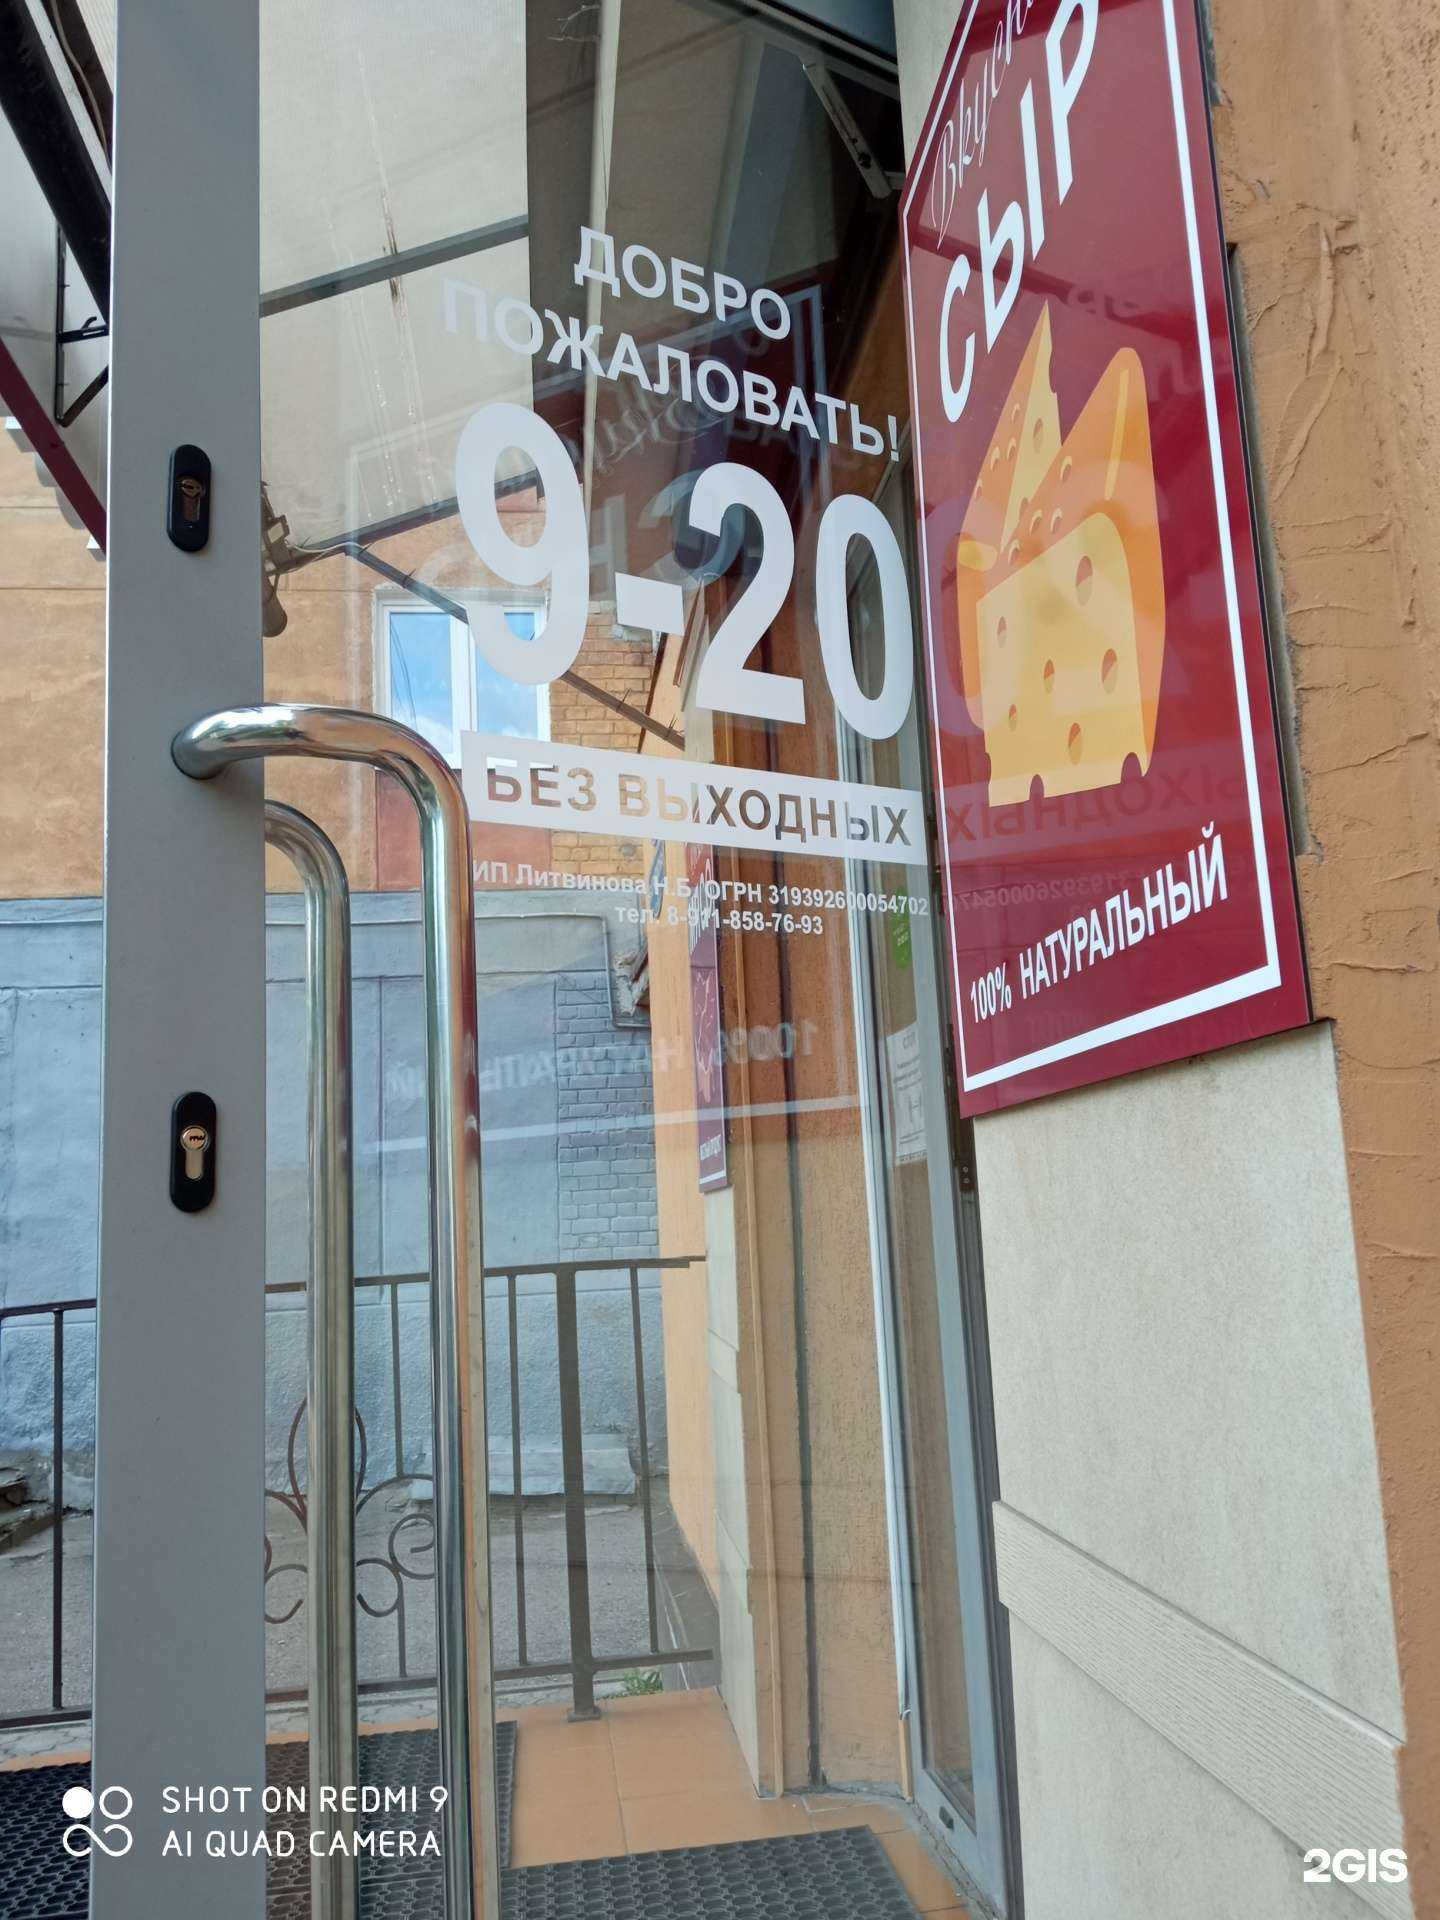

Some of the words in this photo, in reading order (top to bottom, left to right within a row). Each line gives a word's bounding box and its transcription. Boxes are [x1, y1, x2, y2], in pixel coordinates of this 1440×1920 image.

[931, 0, 1034, 249] Вкусн
[574, 226, 791, 340] ДОБРО
[441, 277, 900, 462] ПОЖАЛОВАТЬ!
[455, 402, 915, 741] 9-20
[486, 757, 597, 812] БЕЗ
[619, 773, 912, 847] ВЫХОДНЫХ
[473, 860, 508, 883] ИП
[515, 864, 647, 895] Литвинова
[704, 879, 762, 904] ОГРН
[768, 884, 929, 916] 319392600054702
[615, 906, 660, 925] тел.
[970, 962, 1012, 1023] 100%
[1019, 821, 1228, 999] НАТУРАЛЬНЫЙ
